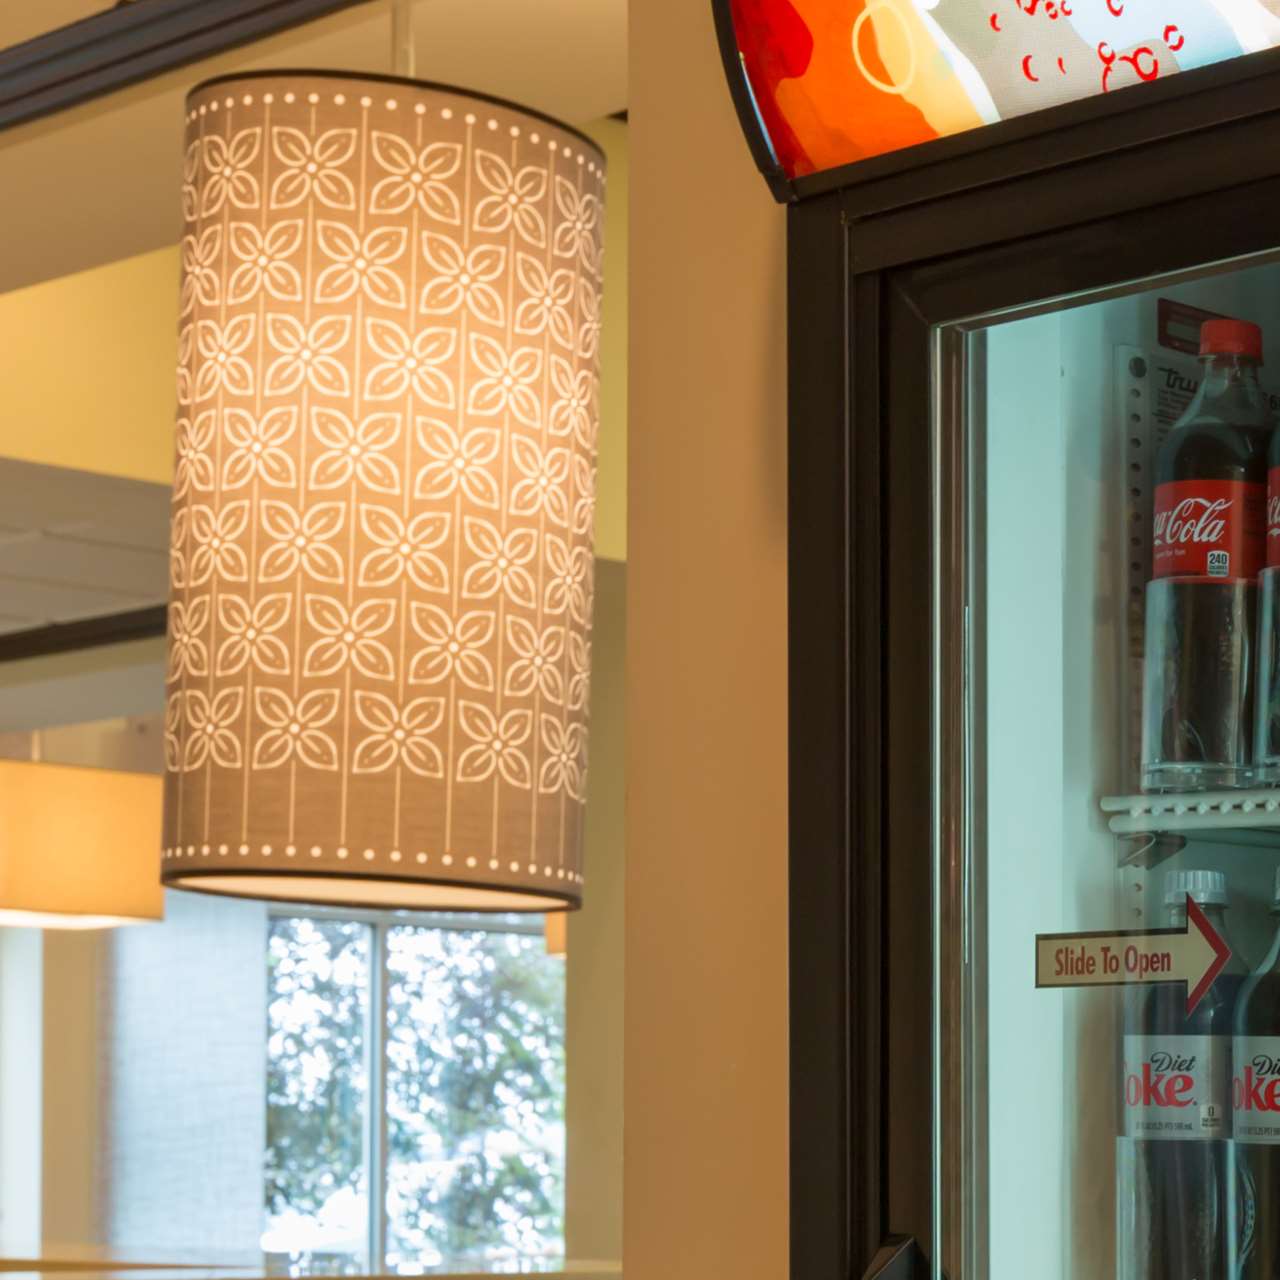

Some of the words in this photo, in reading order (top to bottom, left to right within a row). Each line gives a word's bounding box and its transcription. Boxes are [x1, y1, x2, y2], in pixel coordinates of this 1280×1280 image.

[1207, 551, 1229, 567] 240
[1054, 946, 1096, 976] Slide
[1100, 946, 1119, 974] To
[1124, 945, 1172, 979] Open
[1150, 1051, 1197, 1073] Diet
